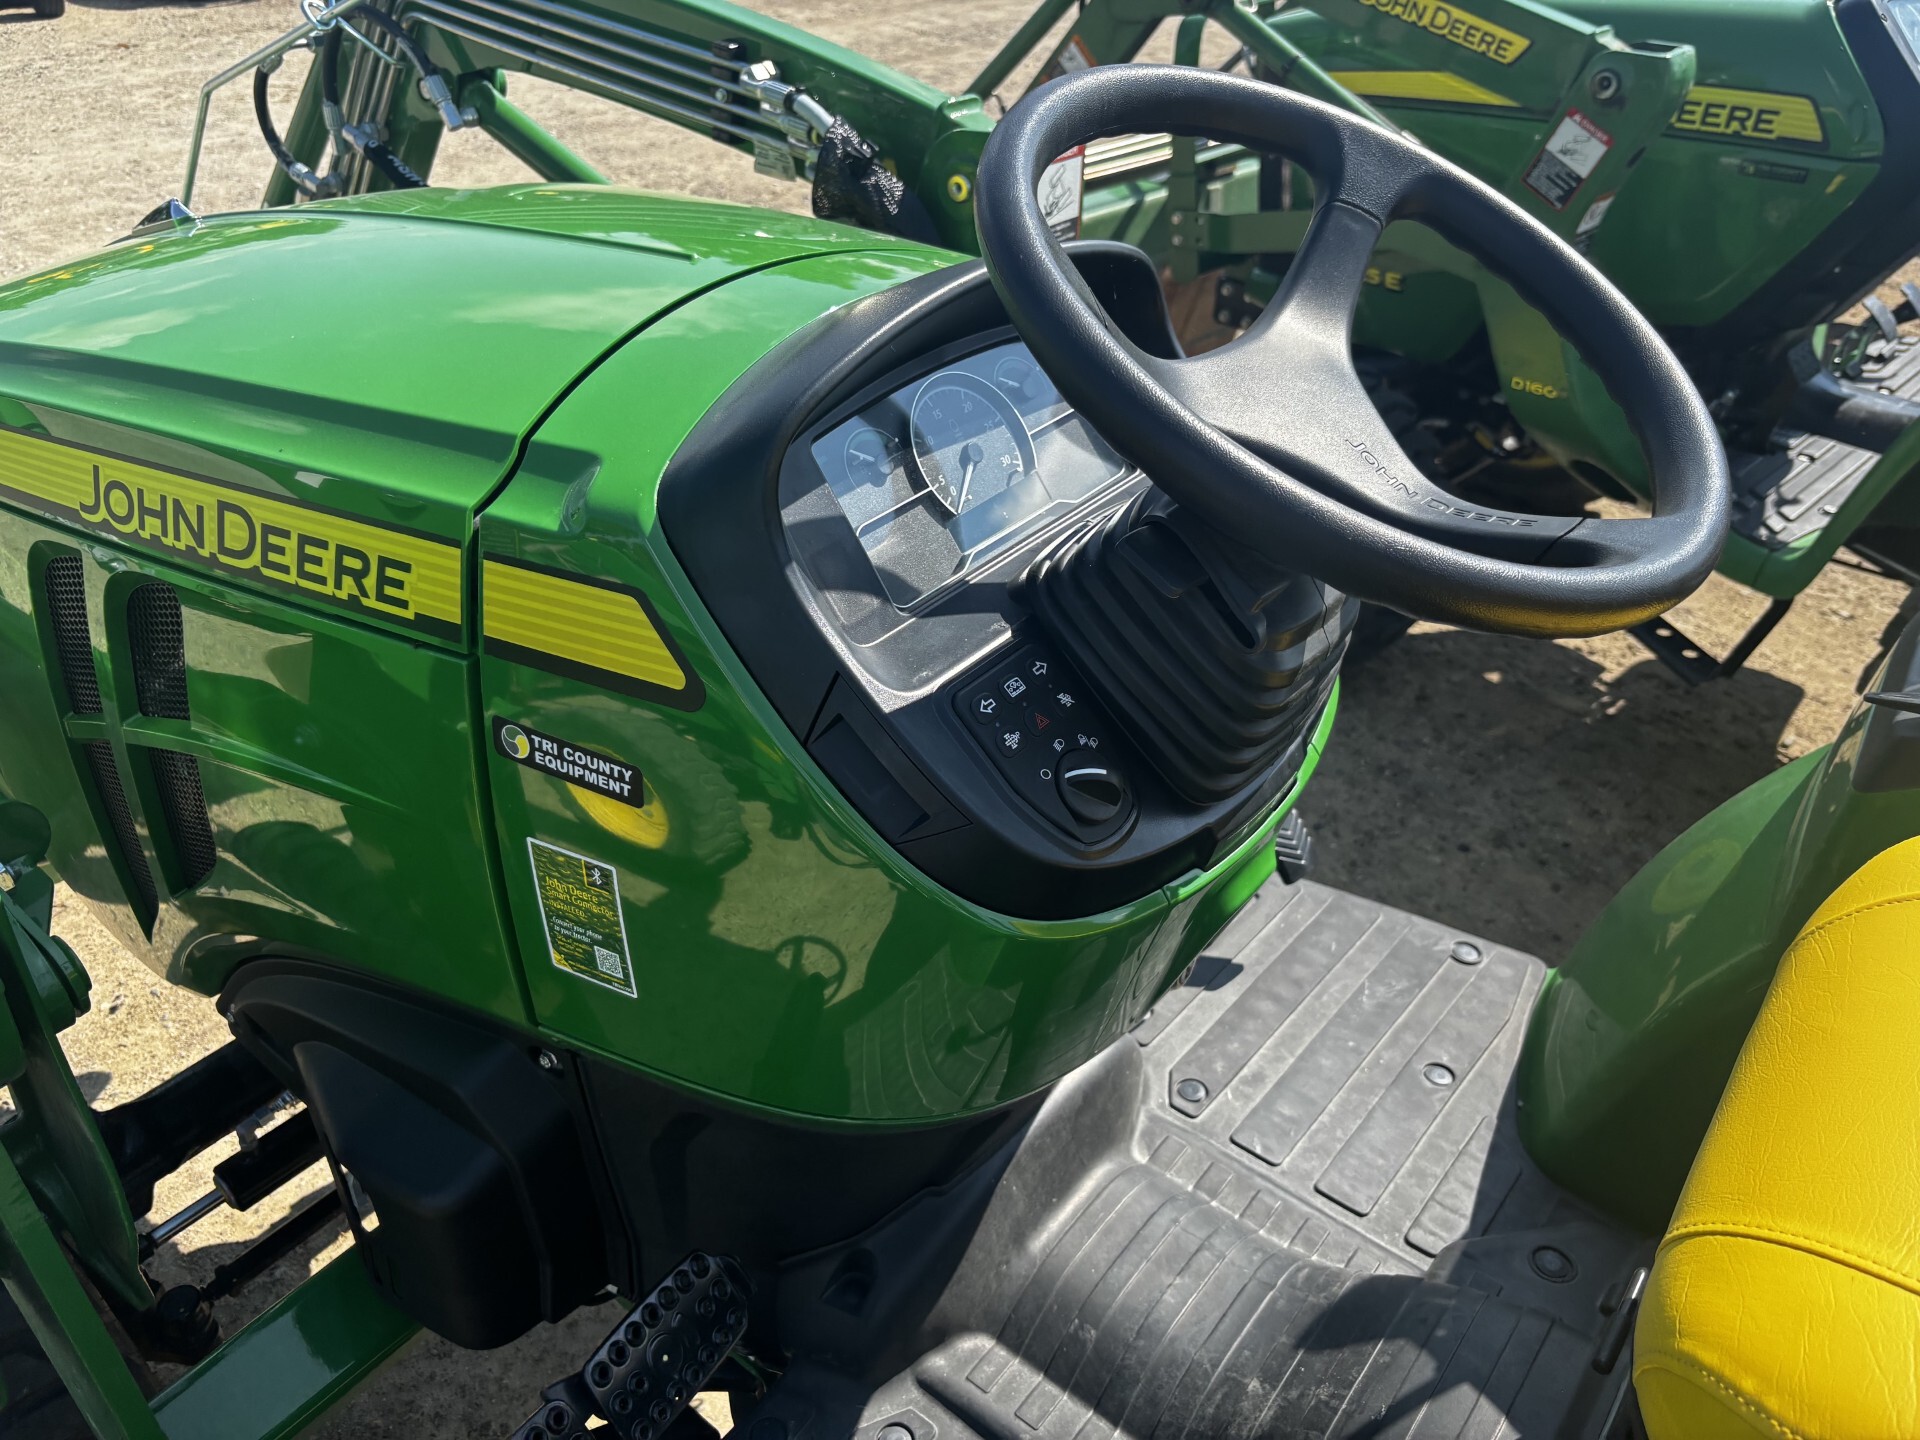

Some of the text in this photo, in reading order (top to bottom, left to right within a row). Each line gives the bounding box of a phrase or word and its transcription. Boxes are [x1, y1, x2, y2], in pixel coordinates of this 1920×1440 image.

[1430, 7, 1512, 59] DEERE
[962, 401, 973, 413] 20
[1000, 454, 1011, 467] 30
[938, 474, 945, 486] 5
[950, 486, 957, 496] 0
[1345, 439, 1538, 527] JOHN DEERE
[79, 464, 412, 611] JOHN DEERE
[531, 734, 633, 782] TRI COUNTY
[534, 750, 632, 797] EQUIPMENT
[545, 876, 599, 904] John Deere
